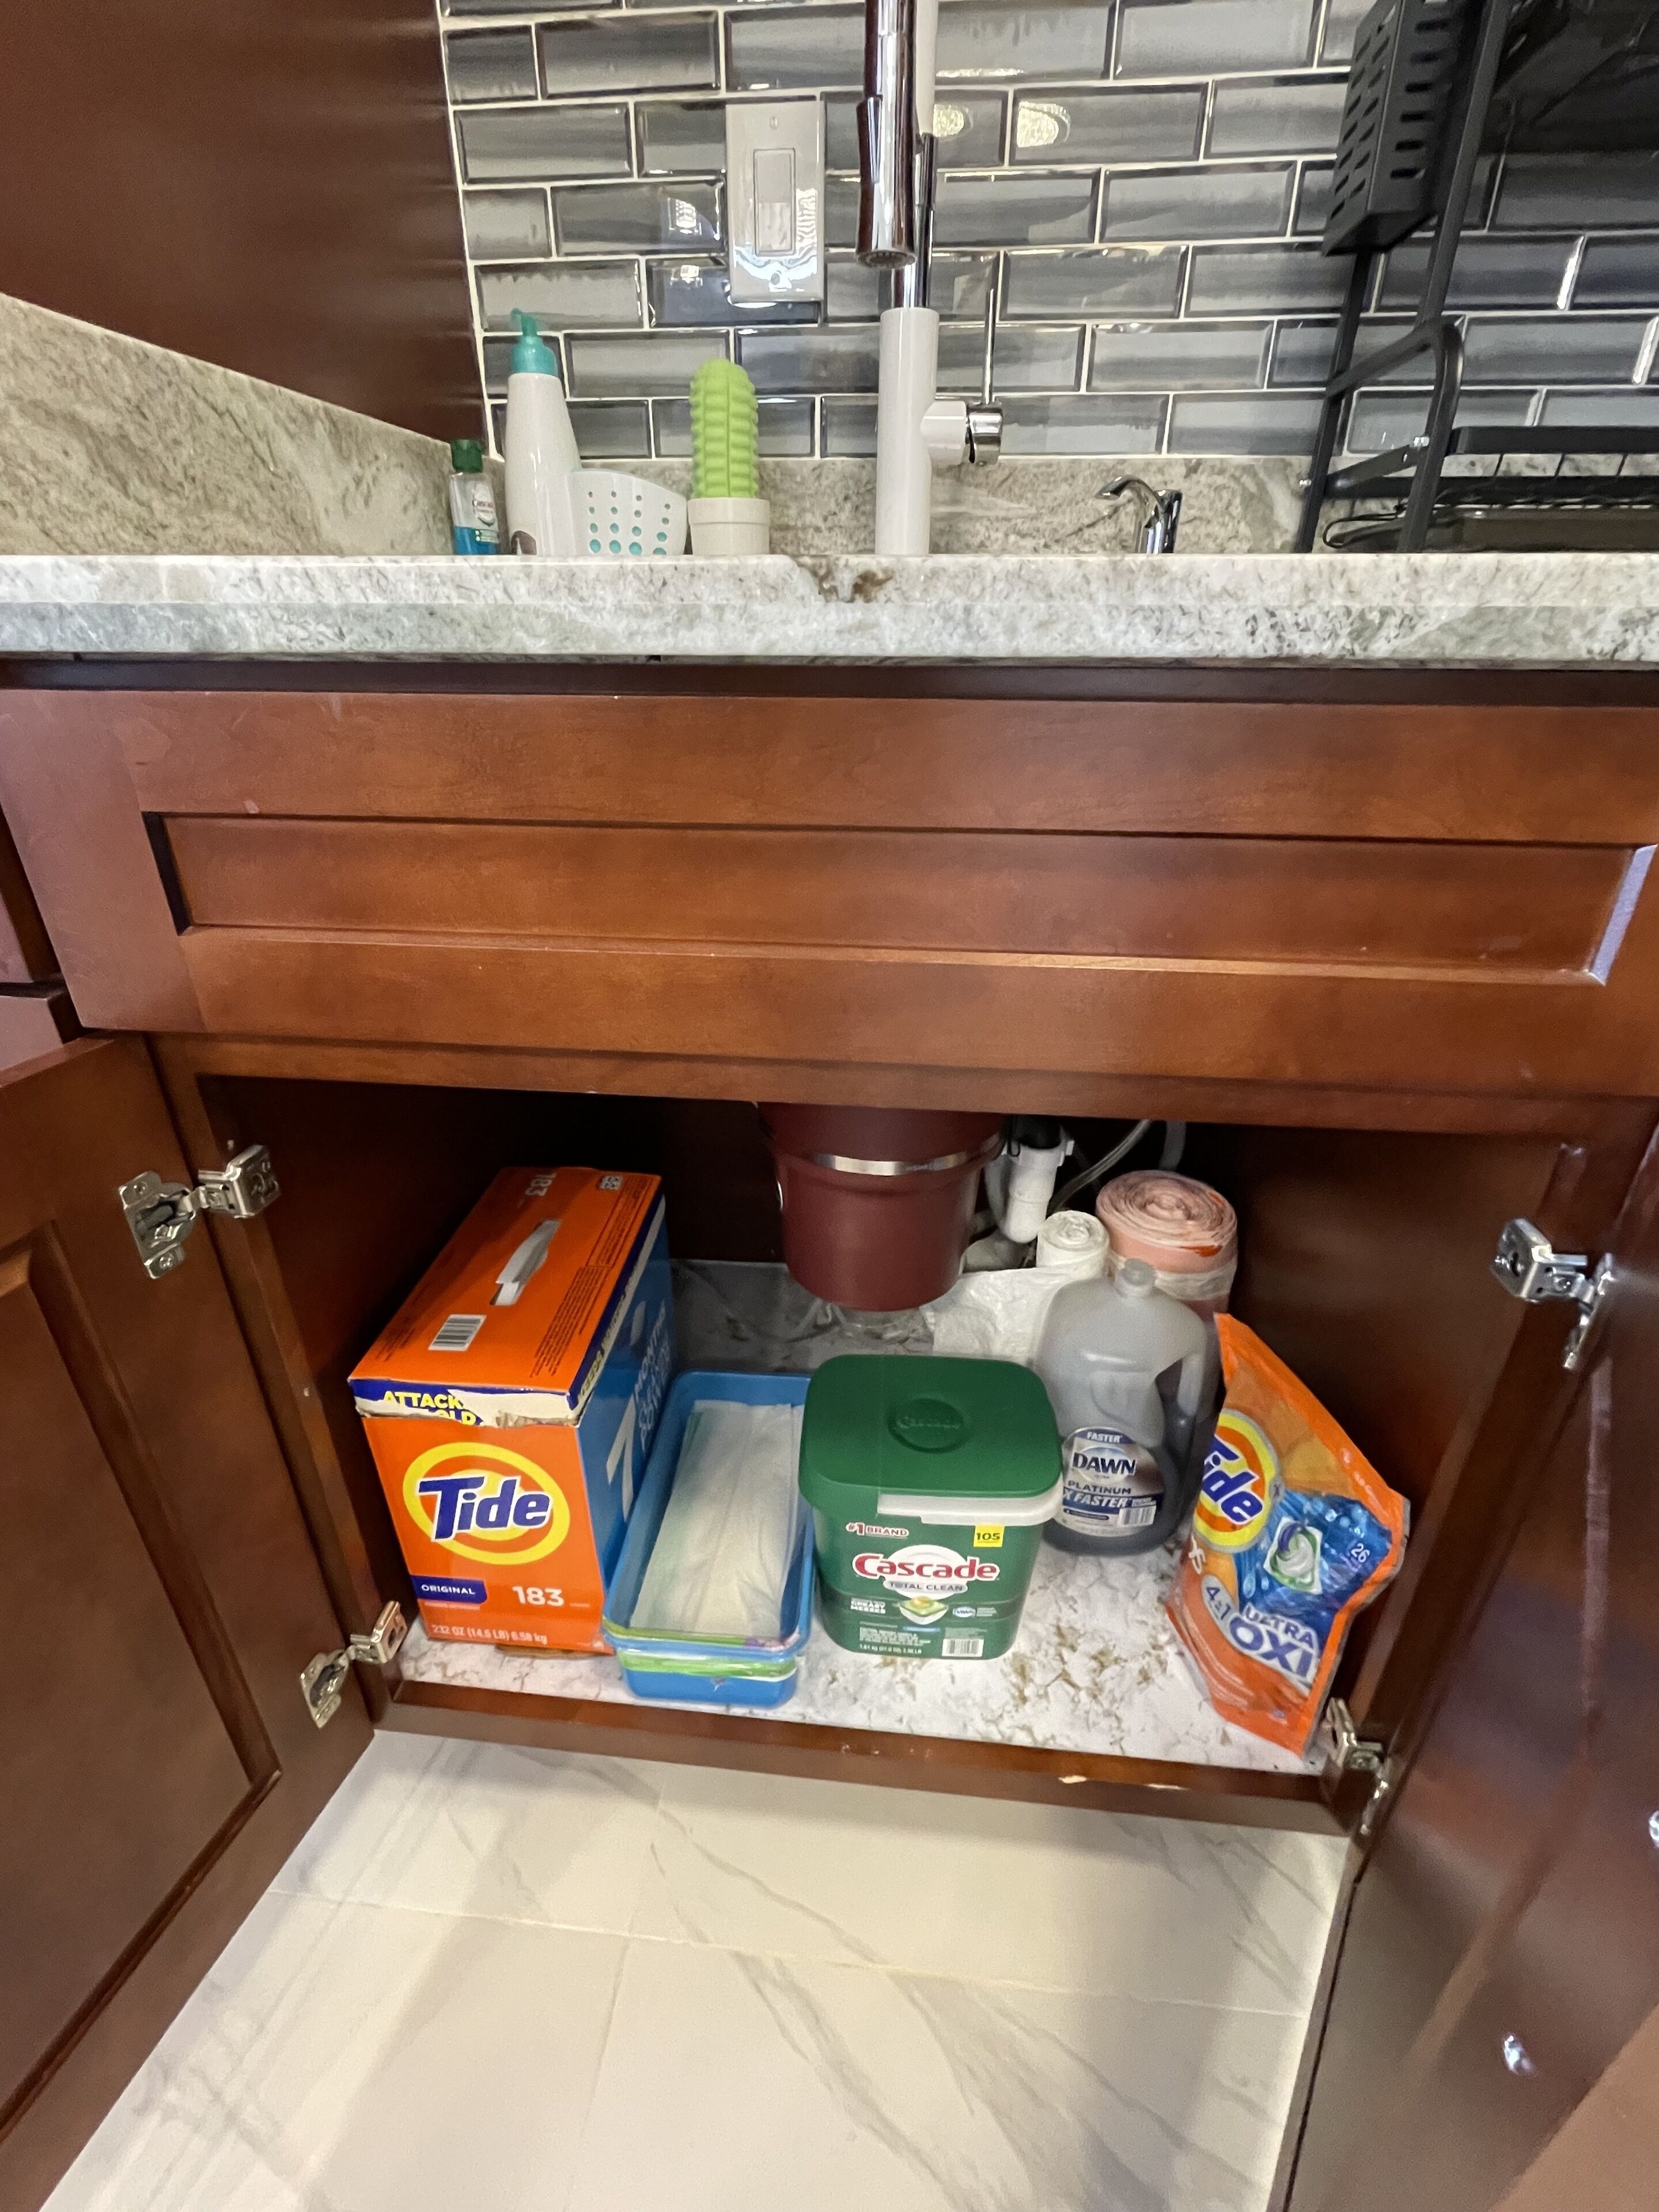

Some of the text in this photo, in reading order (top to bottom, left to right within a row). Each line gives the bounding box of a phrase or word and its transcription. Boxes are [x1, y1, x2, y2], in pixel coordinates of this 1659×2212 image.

[1087, 1431, 1121, 1444] FASTER
[1073, 1452, 1135, 1475] DAWN
[1068, 1480, 1131, 1495] PLATINUM
[418, 1476, 551, 1540] Tide
[1074, 1492, 1129, 1508] FASTER
[848, 1523, 907, 1536] #1 BRAND
[976, 1532, 1001, 1541] 105
[1351, 1543, 1370, 1563] 26
[854, 1555, 998, 1580] Cascade
[421, 1584, 476, 1595] ORIGINAL
[889, 1581, 922, 1590] TOTAL
[512, 1585, 565, 1607] 183
[452, 1626, 465, 1636] OZ
[493, 1629, 510, 1641] LB)
[534, 1633, 548, 1645] kg
[1245, 1605, 1313, 1649] ULTRA
[1229, 1615, 1313, 1678] OXI
